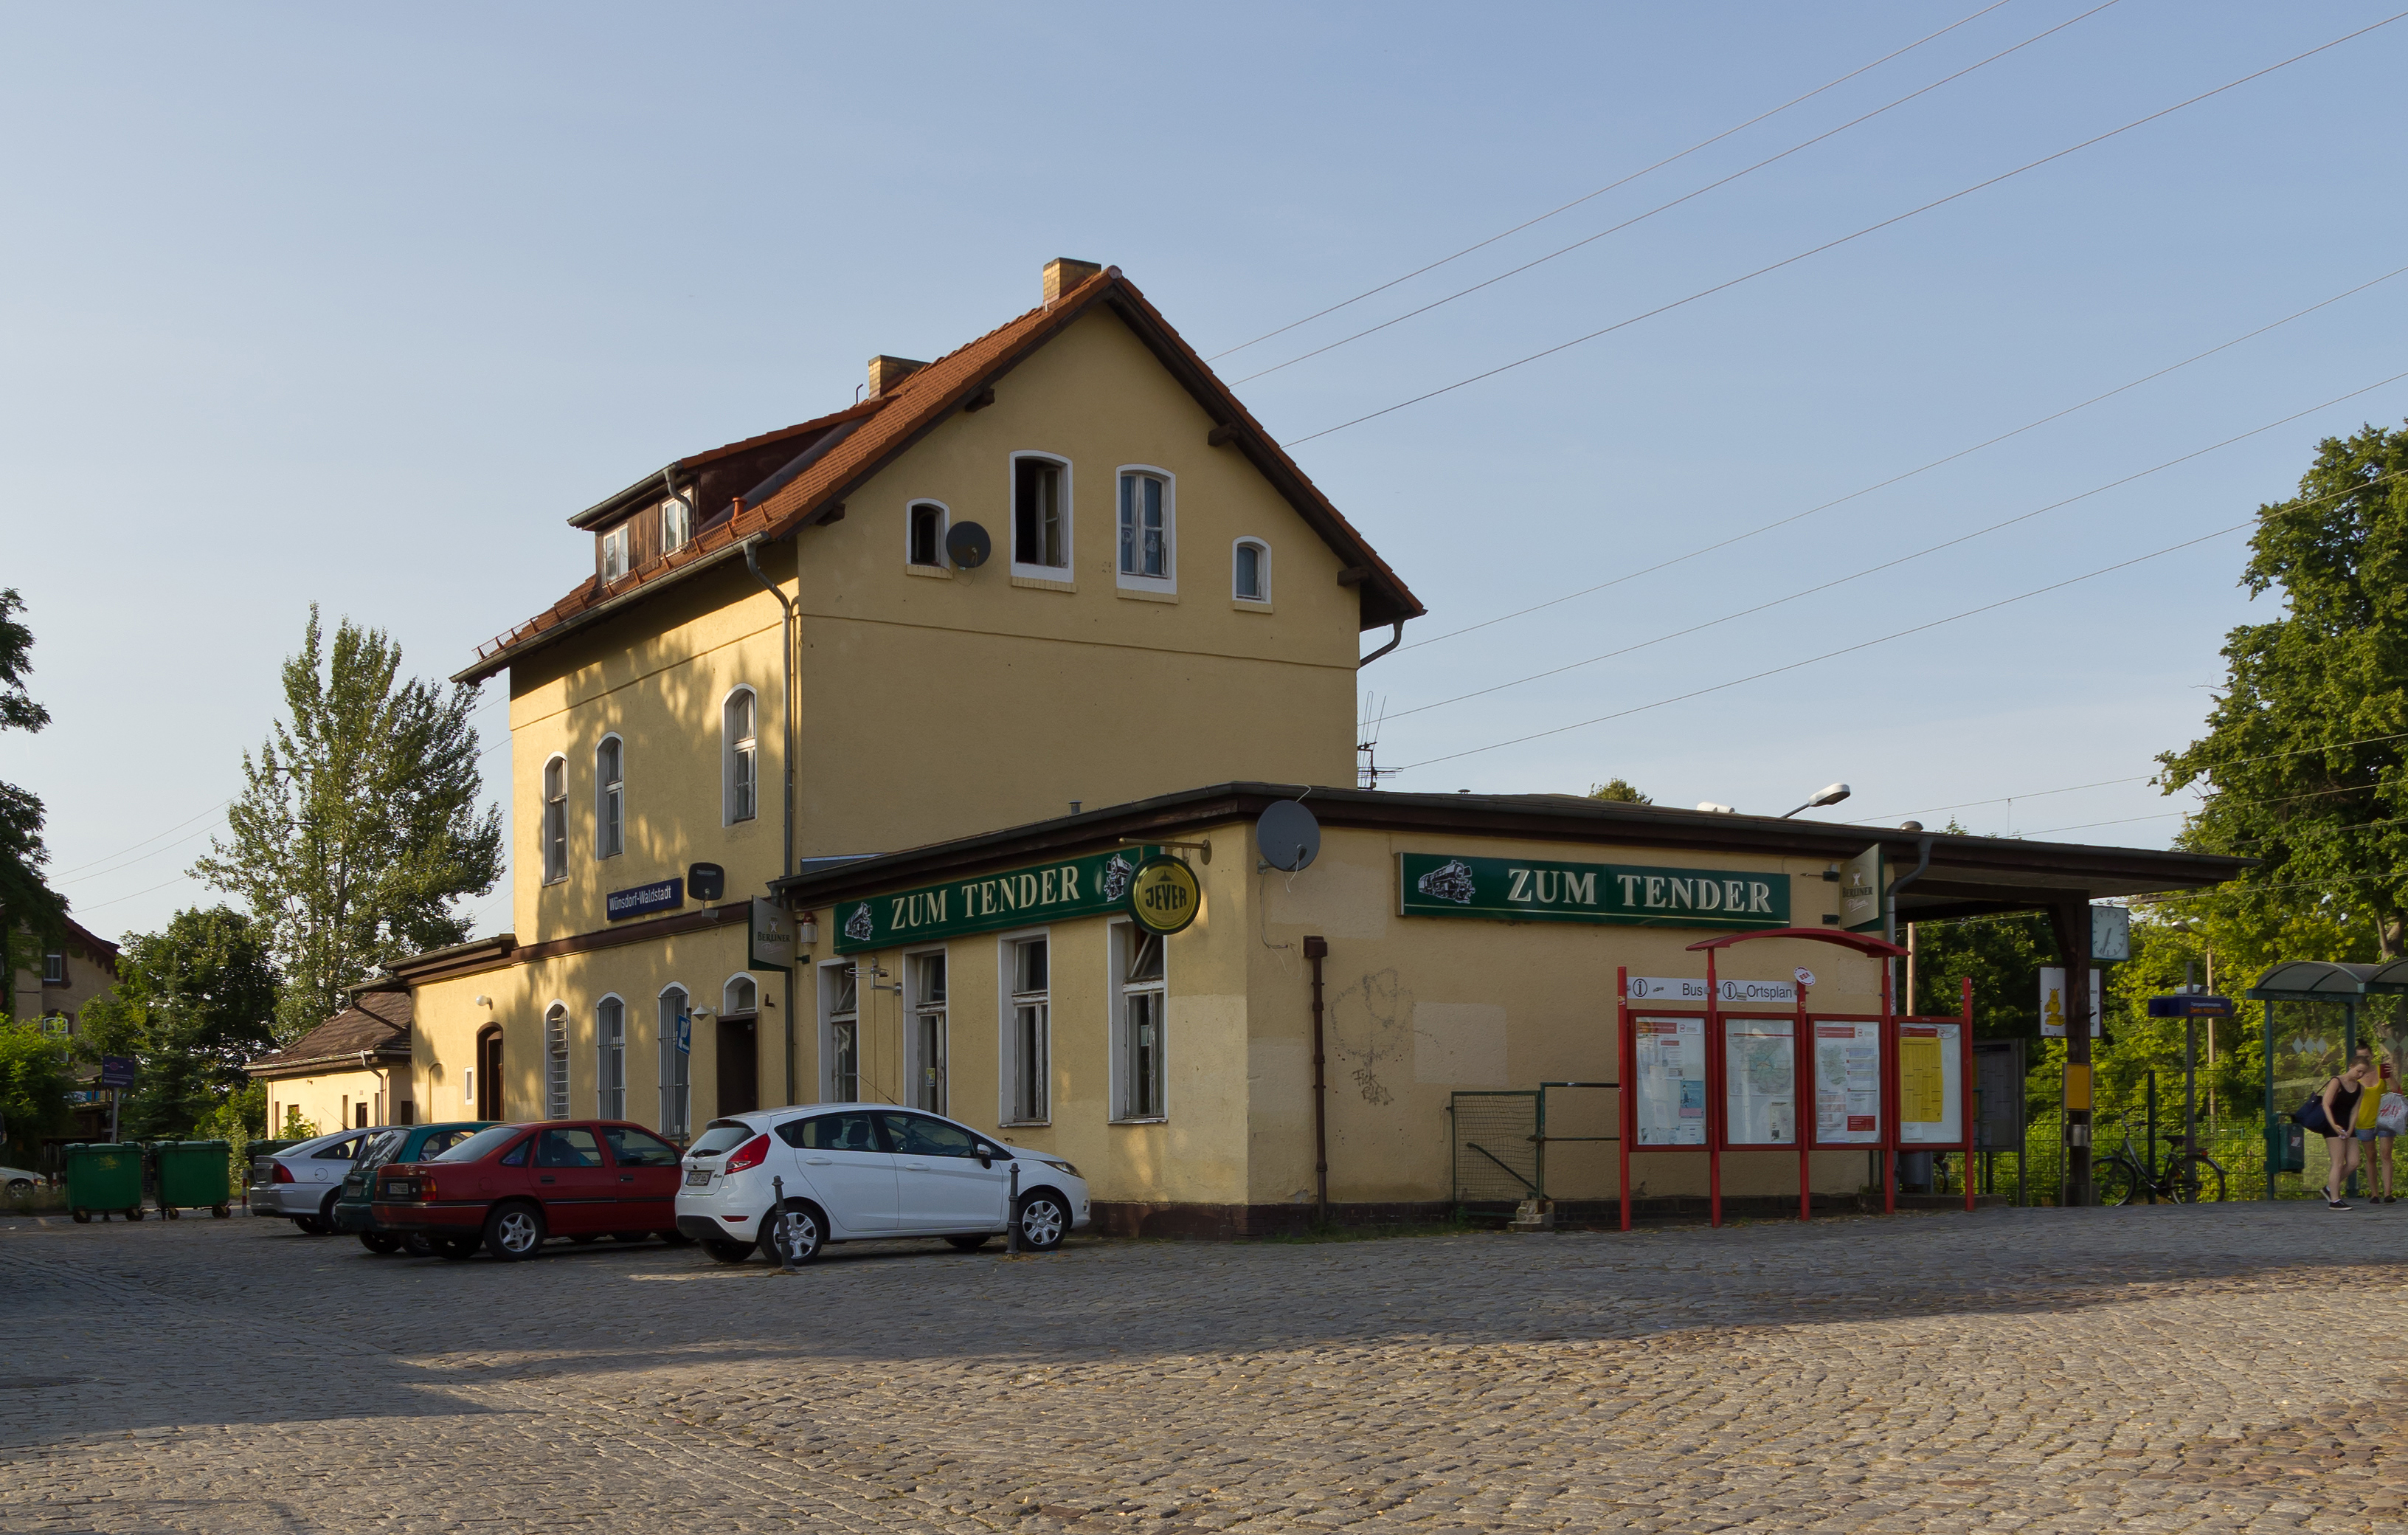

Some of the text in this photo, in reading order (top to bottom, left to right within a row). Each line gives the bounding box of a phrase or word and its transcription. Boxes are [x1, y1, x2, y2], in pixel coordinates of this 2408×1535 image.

[609, 885, 671, 911] Wünsdorf-Waldstadt
[891, 866, 1081, 930] ZUM TENDER
[1145, 884, 1187, 911] JEVER
[1507, 868, 1773, 913] ZUM TENDER
[1842, 886, 1873, 897] BERLINER
[757, 931, 791, 942] BERLINER
[1682, 983, 1703, 996] Bus
[1746, 984, 1792, 1000] Ortsplan
